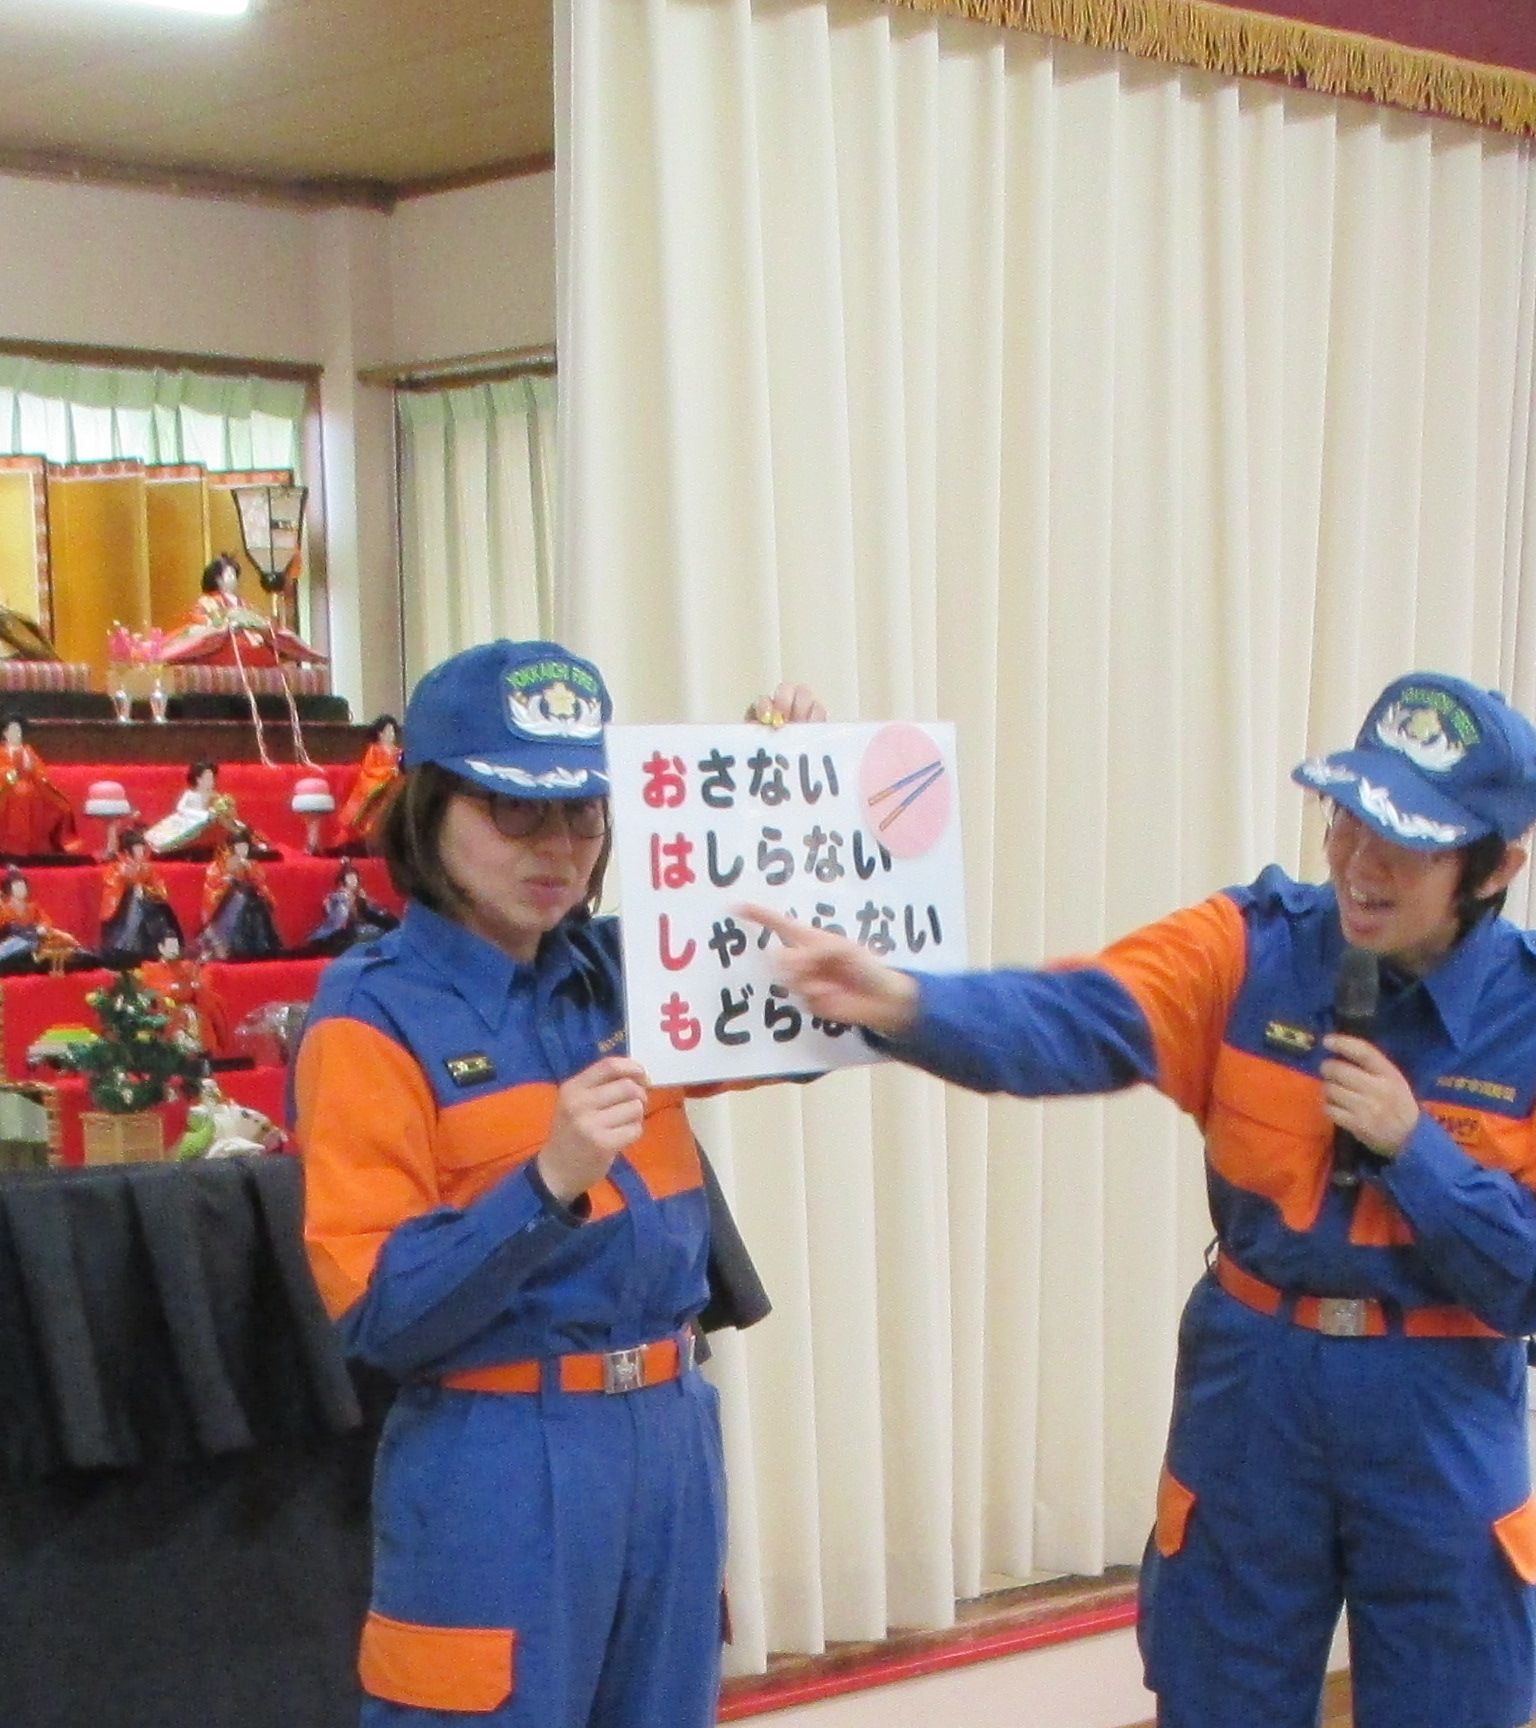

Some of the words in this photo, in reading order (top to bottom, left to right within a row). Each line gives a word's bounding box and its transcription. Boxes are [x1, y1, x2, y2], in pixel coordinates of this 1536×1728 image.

[642, 747, 840, 809] おさない
[650, 825, 893, 891] はしらない
